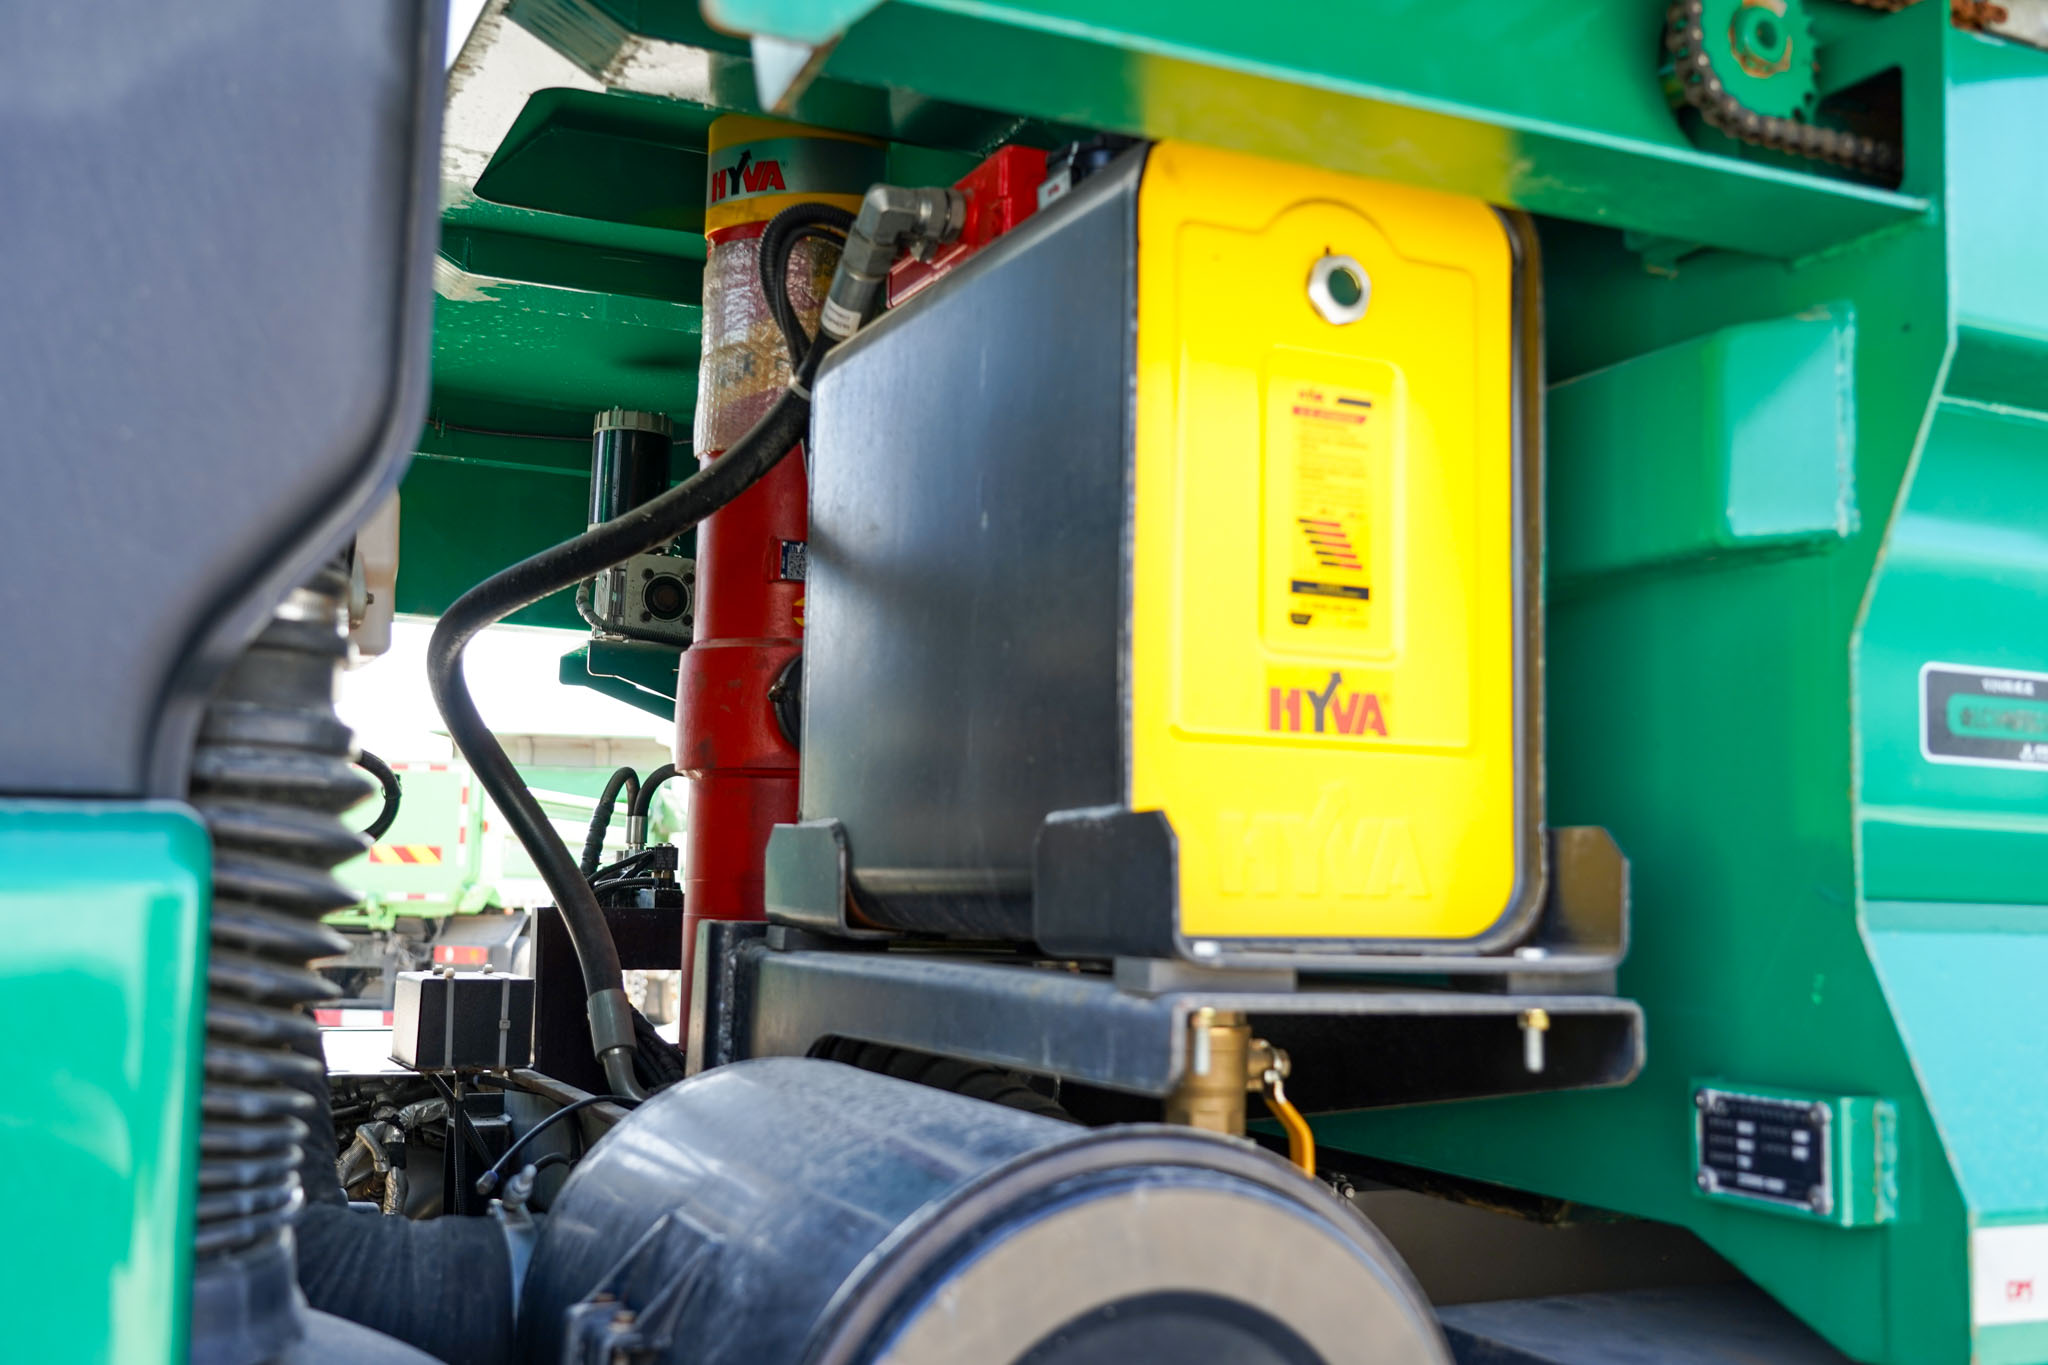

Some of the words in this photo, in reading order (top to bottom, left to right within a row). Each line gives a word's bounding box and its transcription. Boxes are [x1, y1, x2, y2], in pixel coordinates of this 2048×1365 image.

[711, 150, 786, 203] HYVA
[1269, 672, 1388, 736] HYVA
[1218, 779, 1433, 898] HYVA
